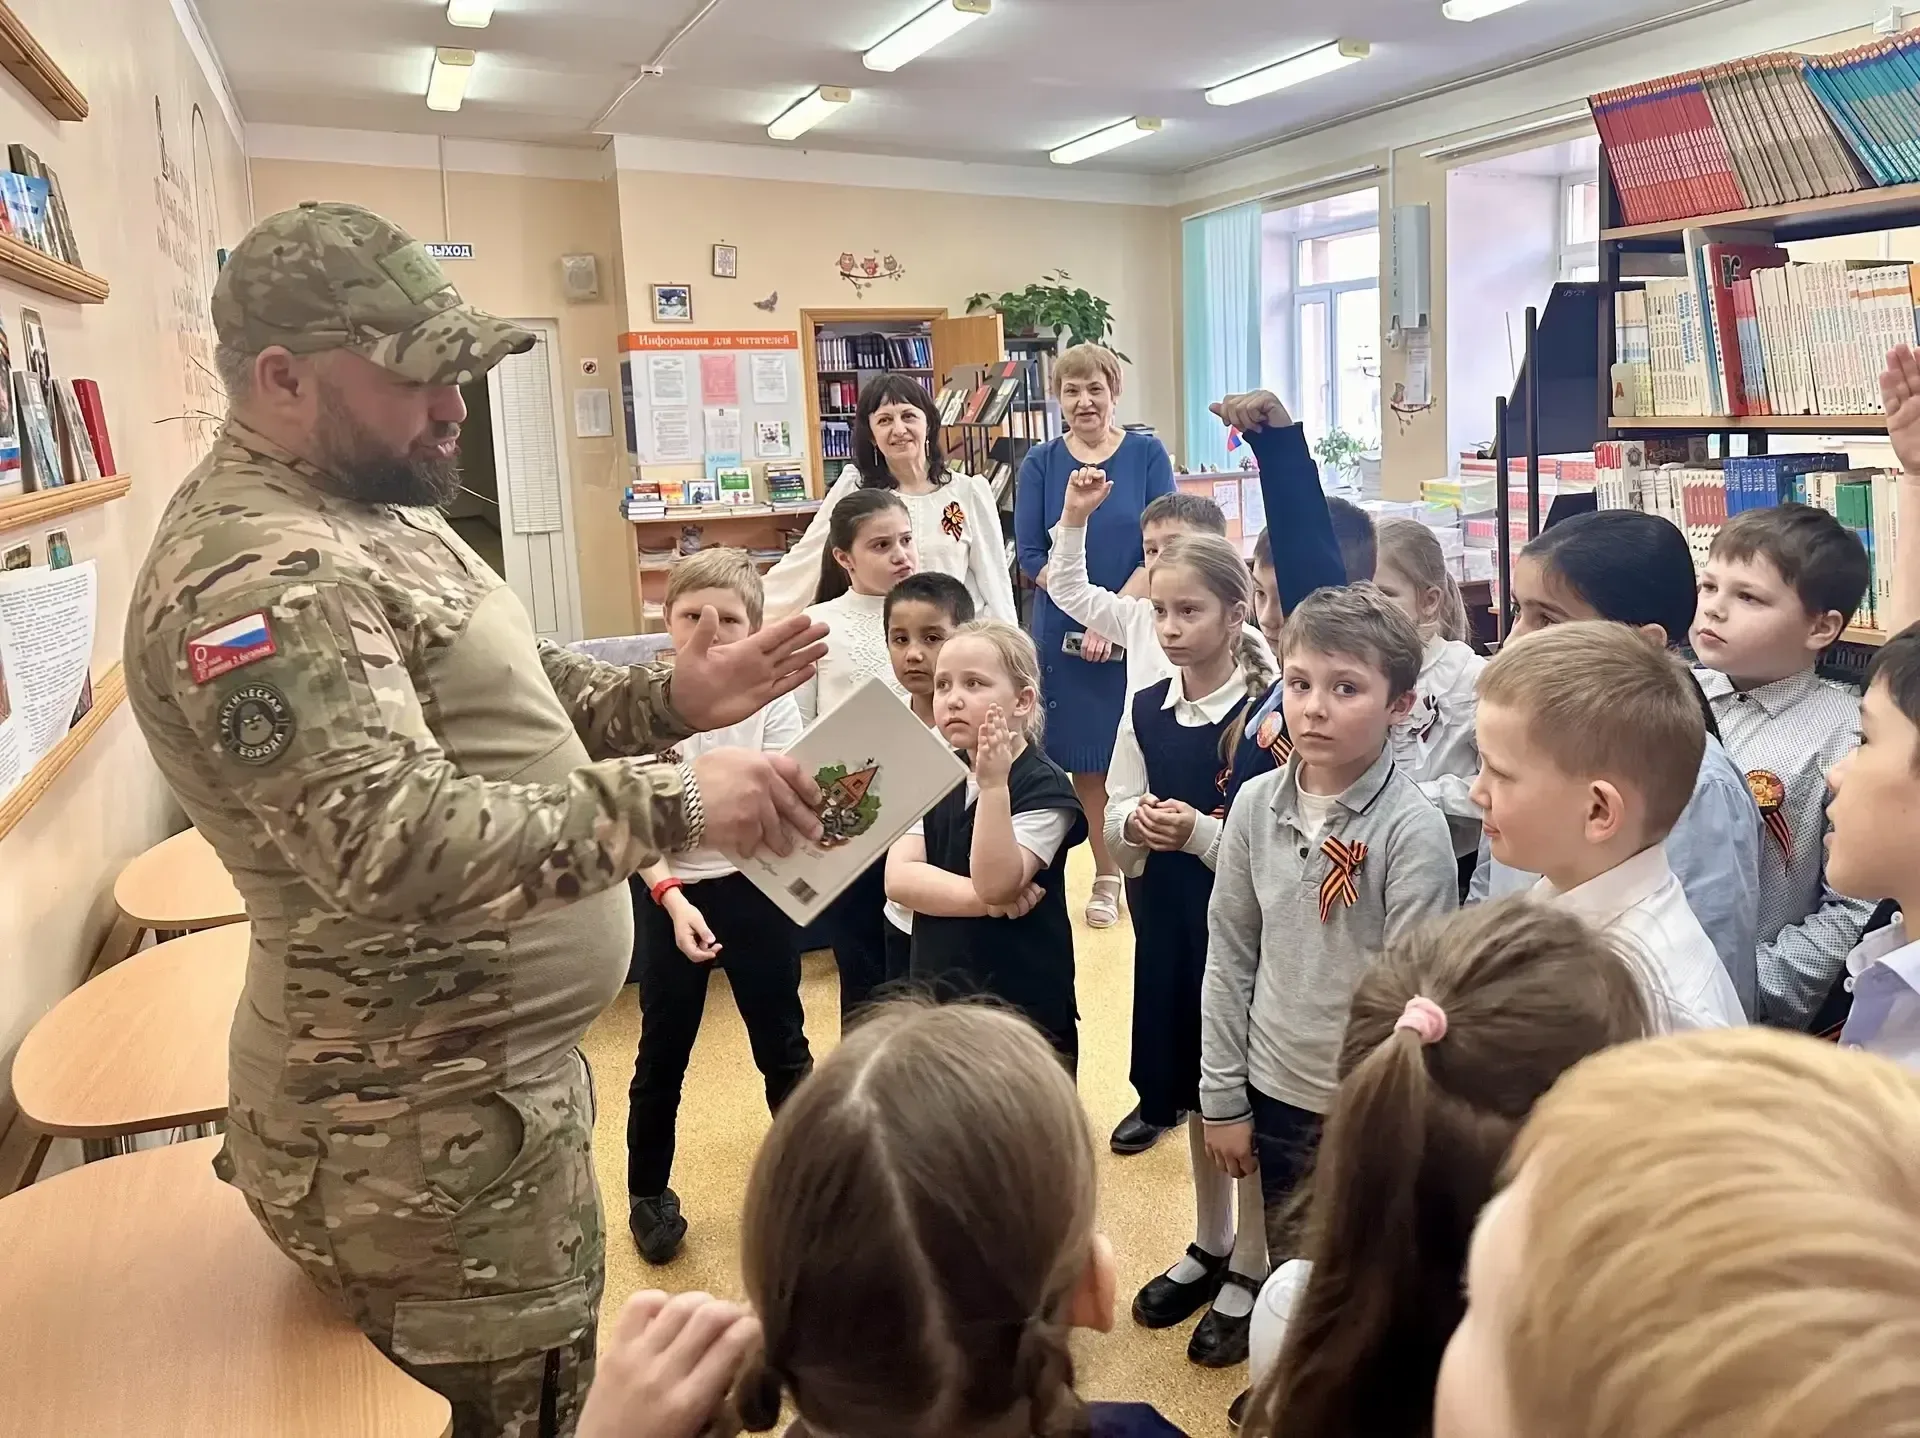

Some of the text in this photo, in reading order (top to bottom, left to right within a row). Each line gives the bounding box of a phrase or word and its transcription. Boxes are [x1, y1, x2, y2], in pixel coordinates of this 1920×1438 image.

[425, 245, 471, 257] ВЫХОД
[638, 334, 790, 347] Информация для читателей
[1615, 380, 1625, 398] А
[221, 688, 283, 733] ТАКТИЧЕСКАЯ
[239, 732, 284, 758] БОРОДА
